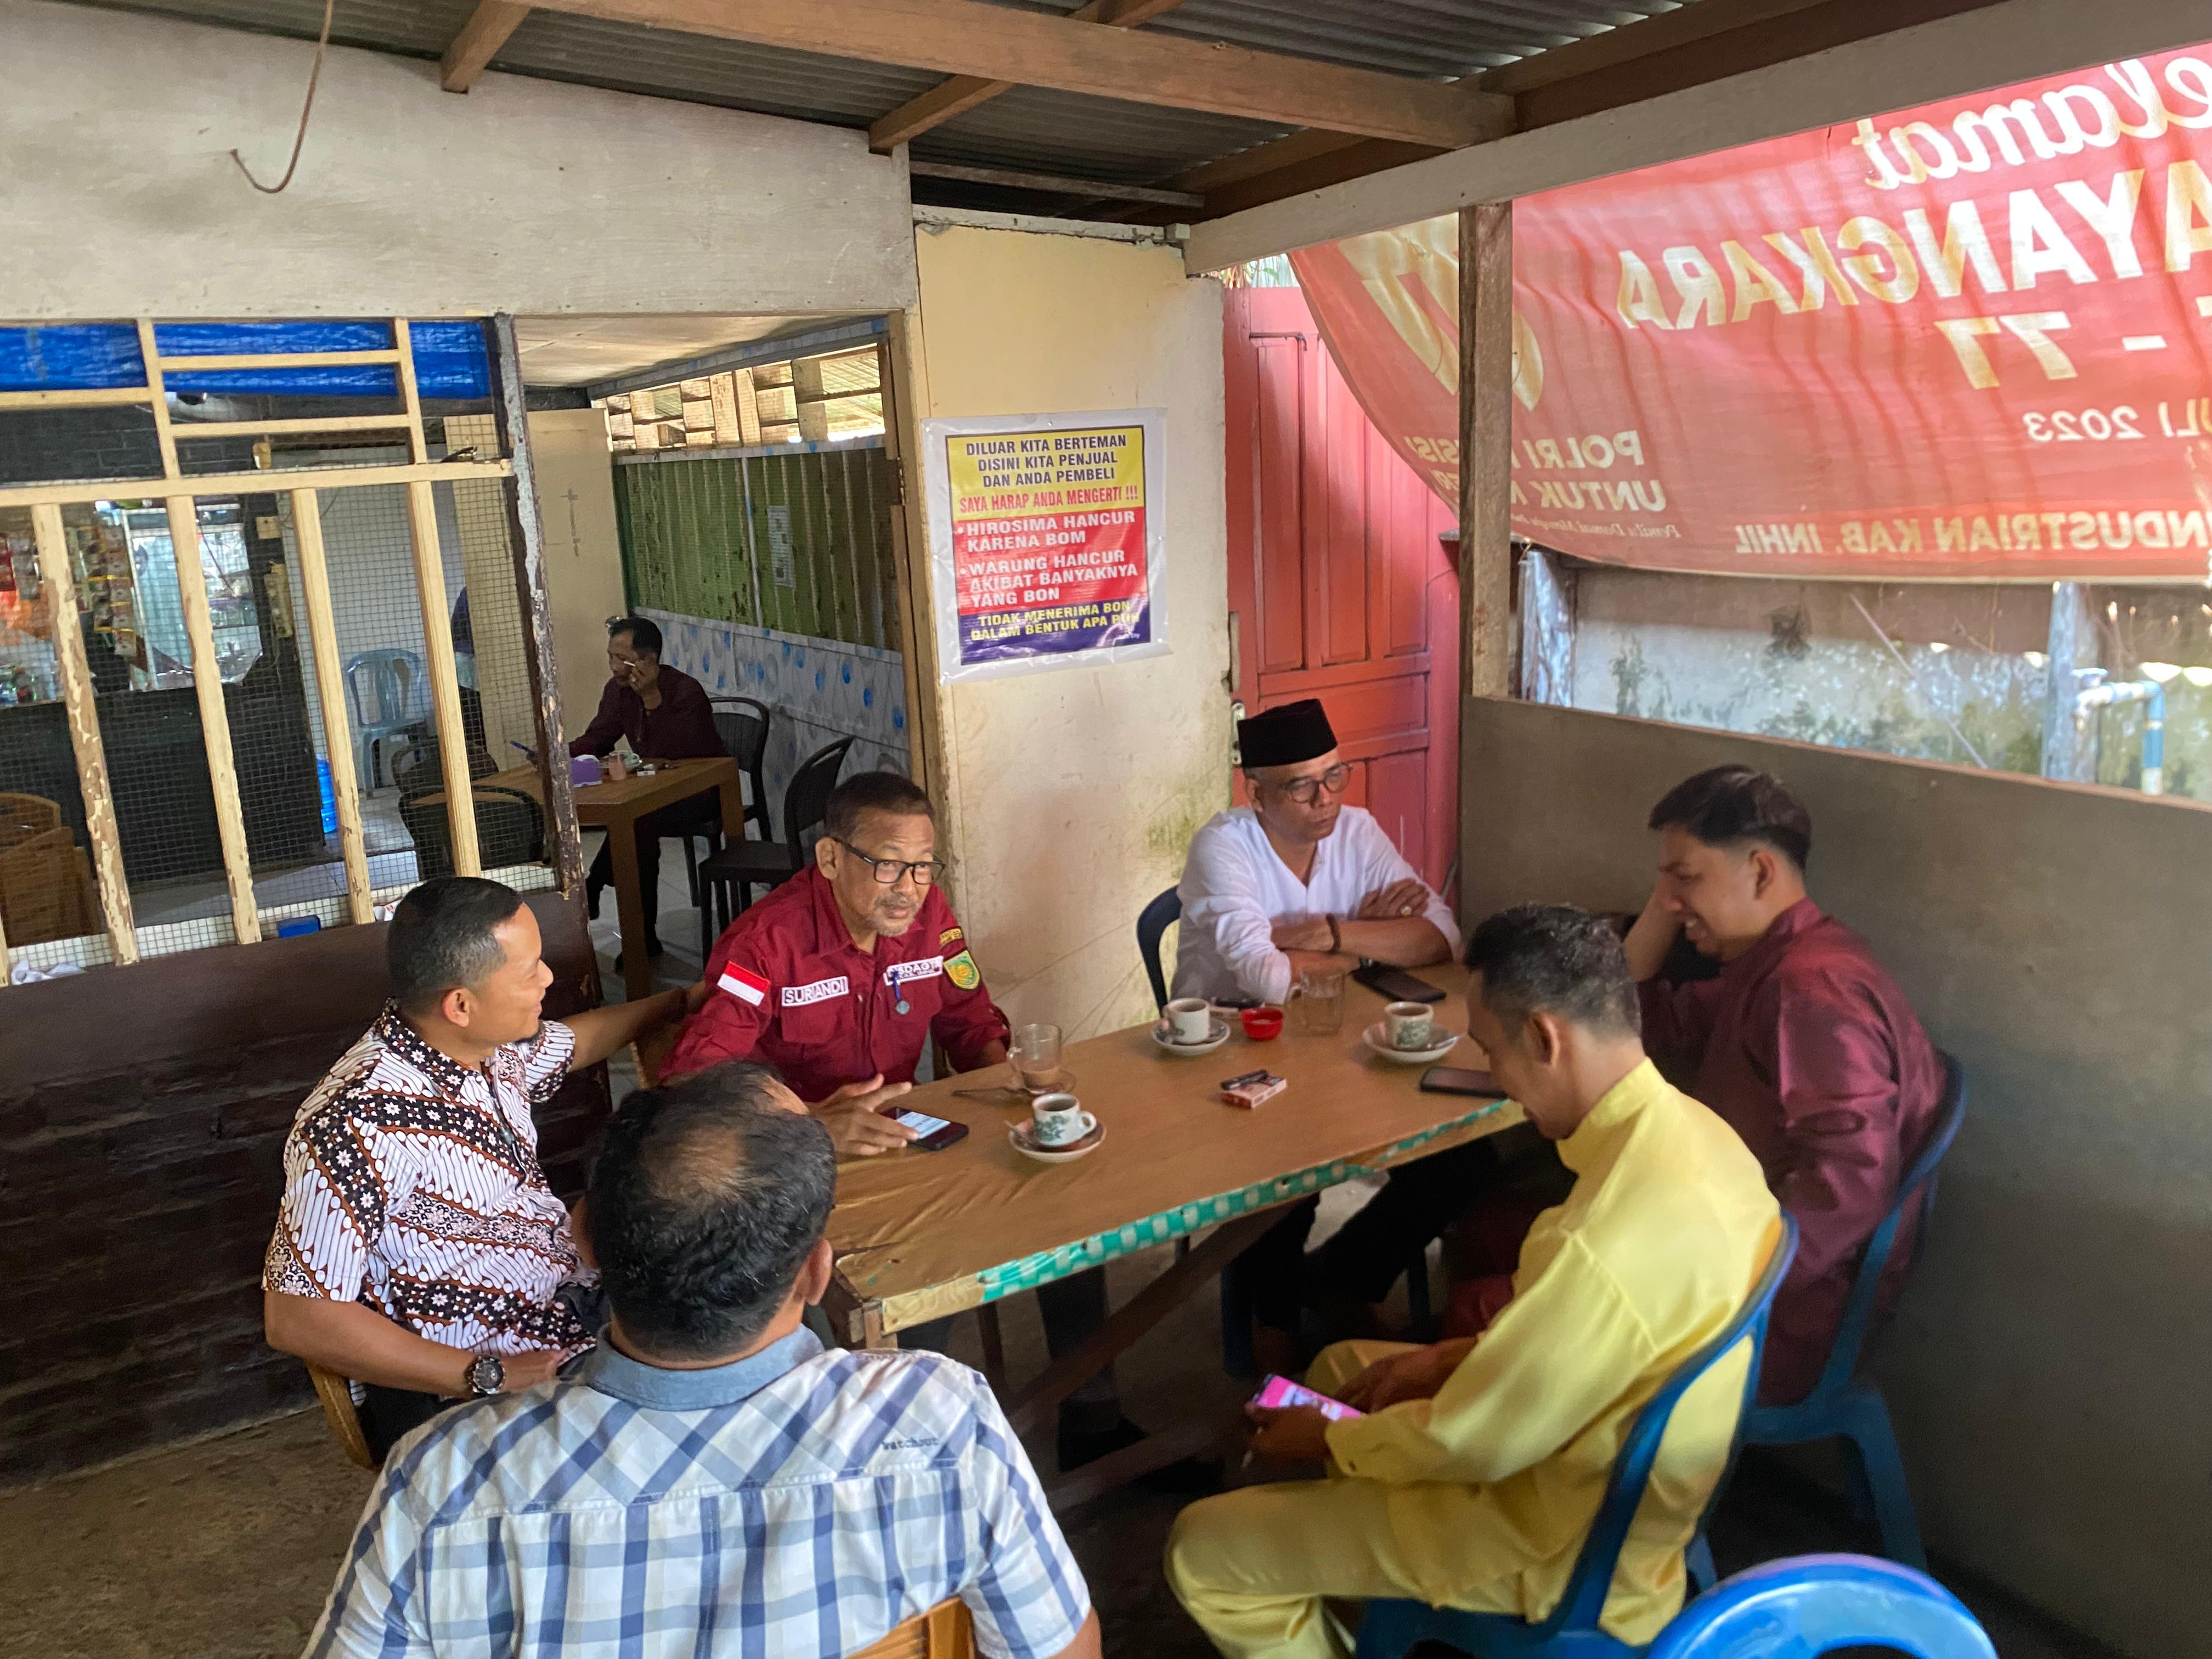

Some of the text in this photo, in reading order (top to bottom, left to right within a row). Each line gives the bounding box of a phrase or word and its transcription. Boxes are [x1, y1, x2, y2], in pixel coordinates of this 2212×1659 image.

[966, 435, 1126, 455] DILUAR KITA BERTEMAN
[978, 452, 1118, 472] DISINI KITA PENJUAL
[983, 467, 1115, 488] DAN ANDA PEMBELI
[960, 485, 1138, 514] SAYA HARAP ANDA MENGERTI !!!
[967, 510, 1136, 536] HIROSIMA HANCUR
[967, 531, 1086, 553] KARENA BOM
[968, 550, 1125, 576] WARUNG HANCUR
[969, 563, 1138, 593] AKIBAT BANYAKNYA
[970, 588, 1059, 608] YANG BON
[979, 600, 1130, 627] TIDAK MENERIMA BON
[970, 625, 1020, 641] DALAM
[1025, 619, 1080, 635] BENTUK
[1082, 616, 1108, 629] APA
[785, 978, 846, 1004] SURIANDI
